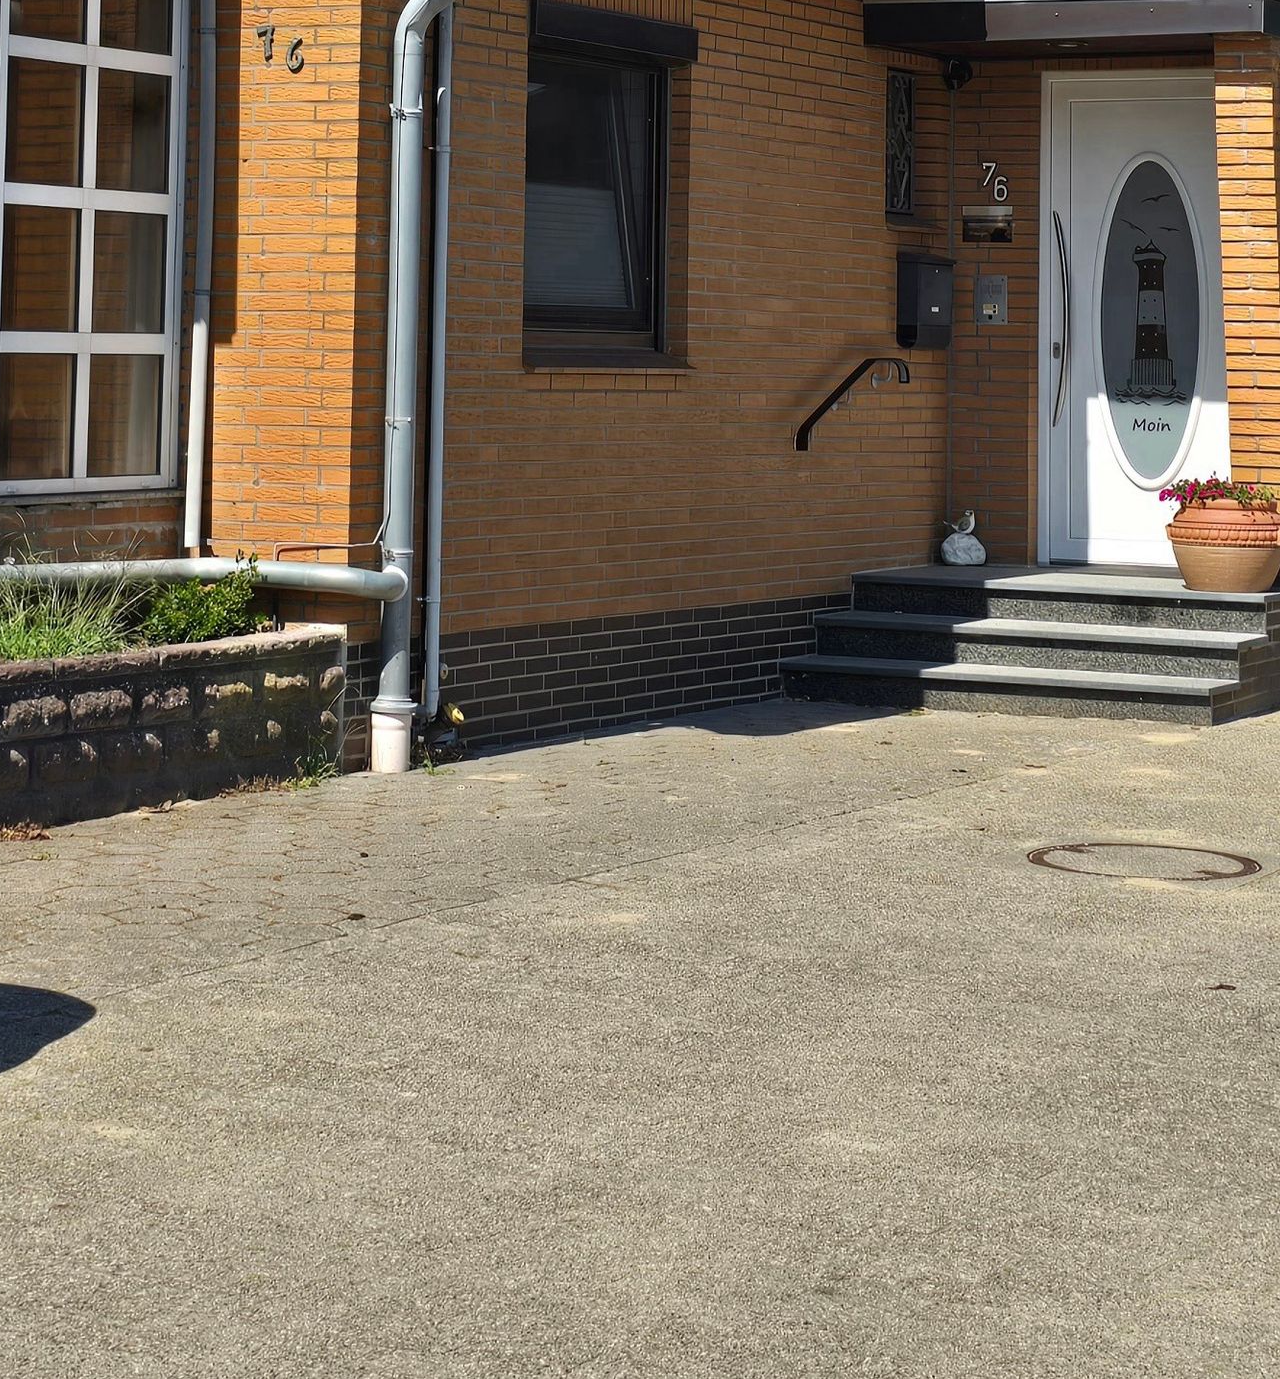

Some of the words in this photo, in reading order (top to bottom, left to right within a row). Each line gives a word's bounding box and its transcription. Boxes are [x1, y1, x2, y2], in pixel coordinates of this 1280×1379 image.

[256, 24, 305, 74] 76
[981, 161, 1009, 202] 76
[1132, 417, 1172, 432] Moin
